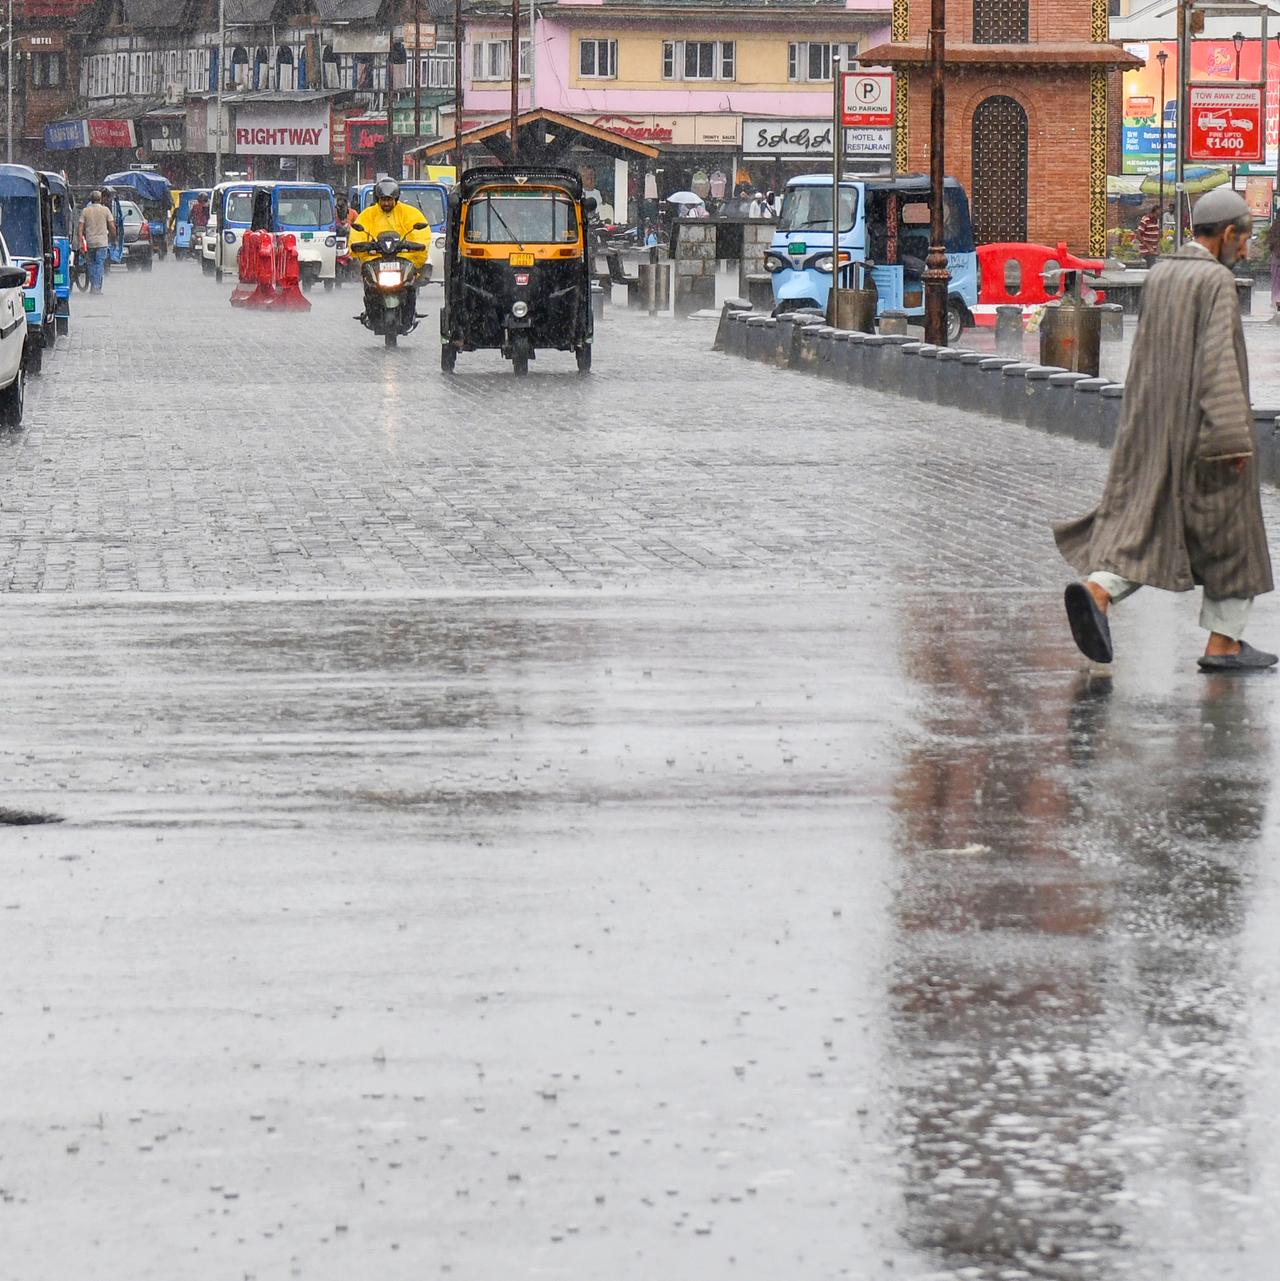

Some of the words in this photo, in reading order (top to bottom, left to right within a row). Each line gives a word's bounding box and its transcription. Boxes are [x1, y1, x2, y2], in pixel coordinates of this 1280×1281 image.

[31, 37, 52, 45] HOTEL
[863, 83, 874, 99] P
[1195, 92, 1213, 100] TOW
[1235, 93, 1257, 101] ZONE
[236, 127, 323, 146] RIGHTWAY
[757, 127, 831, 150] SAGA
[1206, 137, 1244, 149] ₹1400
